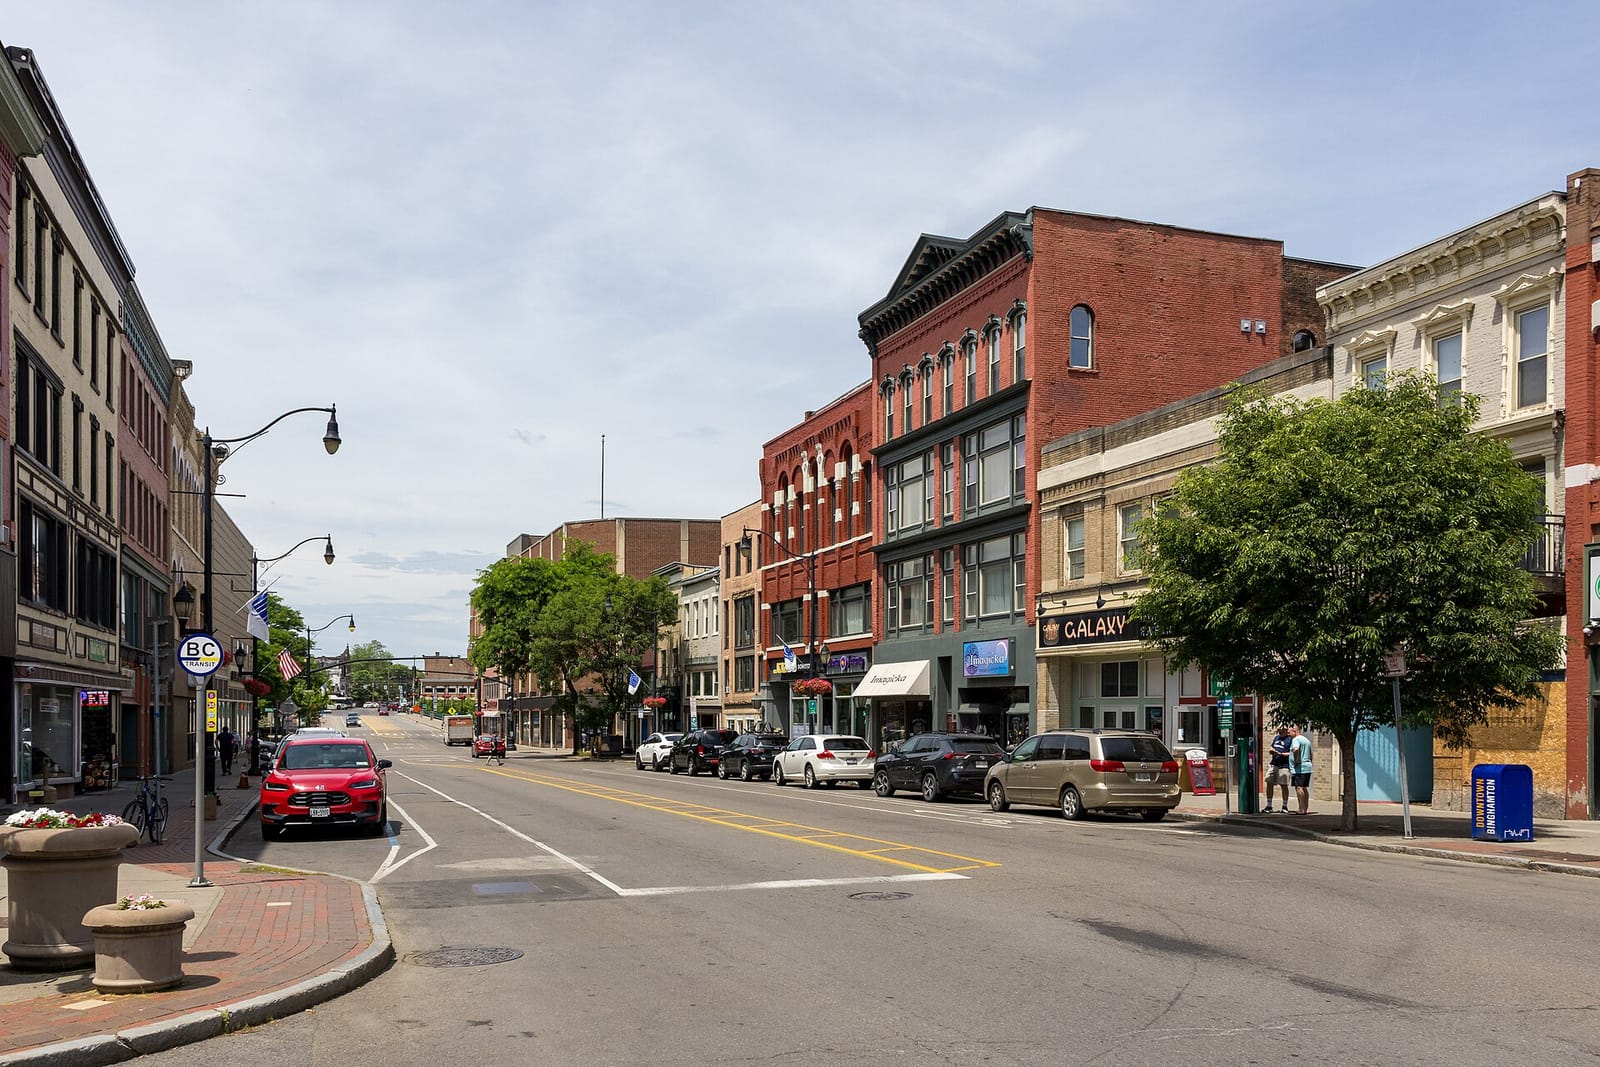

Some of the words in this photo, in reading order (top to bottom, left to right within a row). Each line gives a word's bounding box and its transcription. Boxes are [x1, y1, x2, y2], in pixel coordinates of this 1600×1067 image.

[1064, 615, 1126, 639] GALAXY
[187, 642, 215, 657] BC
[970, 654, 1005, 666] Imagicka
[870, 674, 907, 686] Imagicka
[80, 691, 109, 706] PEN
[1476, 778, 1485, 828] DOWNTOWN
[1486, 779, 1496, 835] BINGHAMTON
